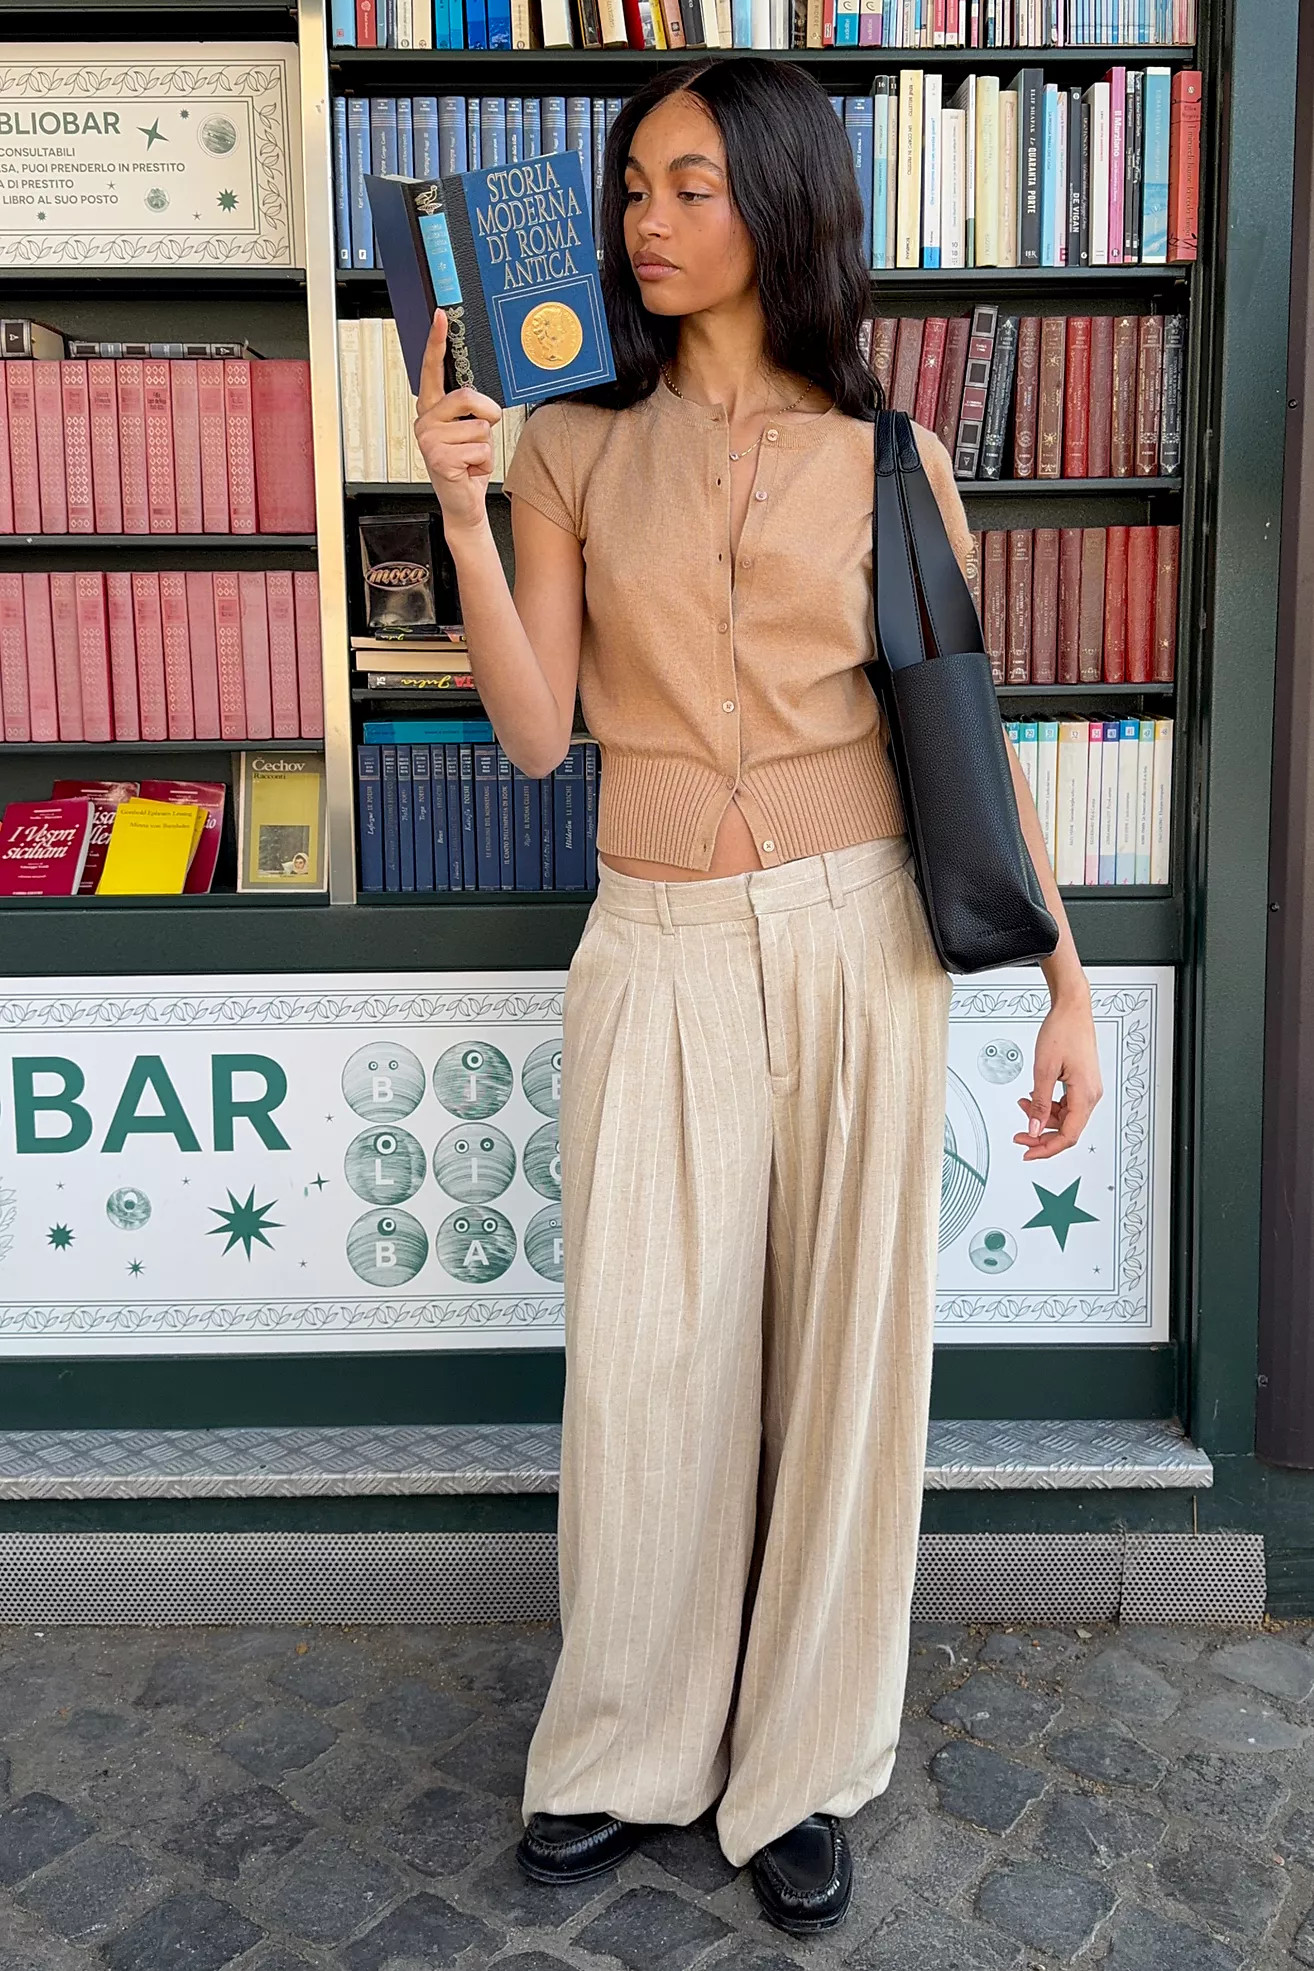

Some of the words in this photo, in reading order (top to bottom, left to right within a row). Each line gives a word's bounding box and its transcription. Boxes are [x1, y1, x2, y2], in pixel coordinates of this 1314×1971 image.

[0, 111, 121, 135] BLIOBAR
[1113, 117, 1122, 157] Marziano
[0, 147, 75, 157] CONSULTABILI
[0, 163, 19, 174] SA,
[22, 163, 48, 173] PUOI
[51, 163, 116, 173] PRENDERLO
[118, 163, 130, 172] IN
[132, 162, 186, 172] PRESTITO
[1027, 147, 1037, 186] QUARANTA
[7, 180, 19, 189] DI
[21, 179, 74, 189] PRESTITO
[486, 161, 561, 203] STORIA
[3, 195, 35, 204] LIBRO
[37, 195, 52, 204] AL
[54, 195, 78, 204] SUO
[80, 194, 119, 204] POSTO
[1027, 190, 1036, 214] PORTE
[1072, 192, 1080, 204] DE
[476, 187, 583, 237] MODERNA
[1072, 206, 1080, 233] VIGAN
[486, 233, 513, 265] DI
[517, 219, 582, 259] ROMA
[503, 249, 579, 290] ANTICA
[401, 674, 452, 689] Julia
[252, 757, 306, 772] Čechov
[93, 807, 117, 824] isa
[8, 826, 25, 842] I
[25, 823, 80, 847] Vespri
[2, 841, 72, 860] siciliani
[371, 1076, 394, 1103] B
[0, 1053, 292, 1155] BAR
[375, 1159, 394, 1185] L
[376, 1241, 398, 1268] B
[462, 1240, 491, 1267] A
